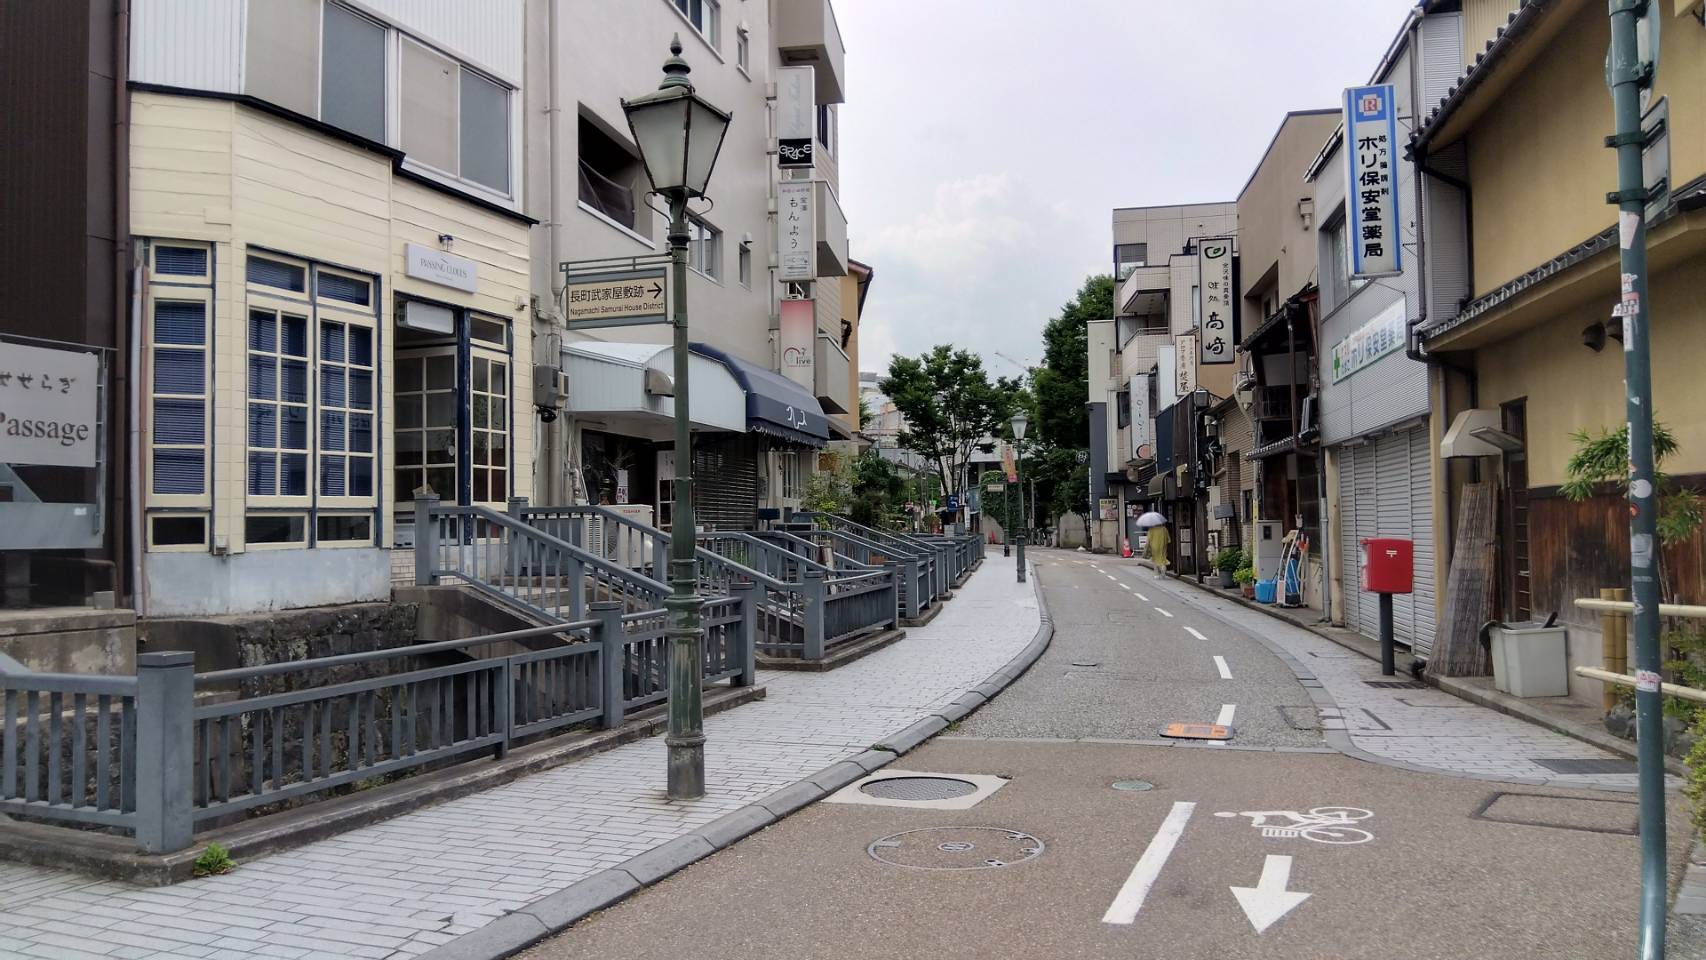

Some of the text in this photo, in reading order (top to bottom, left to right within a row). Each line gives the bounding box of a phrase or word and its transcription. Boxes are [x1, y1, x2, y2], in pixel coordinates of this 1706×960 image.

[1358, 137, 1383, 258] ホリ保安堂薬局
[570, 285, 645, 303] 長町武家屋敷跡
[570, 301, 664, 317] Nagamachi Samurai House District
